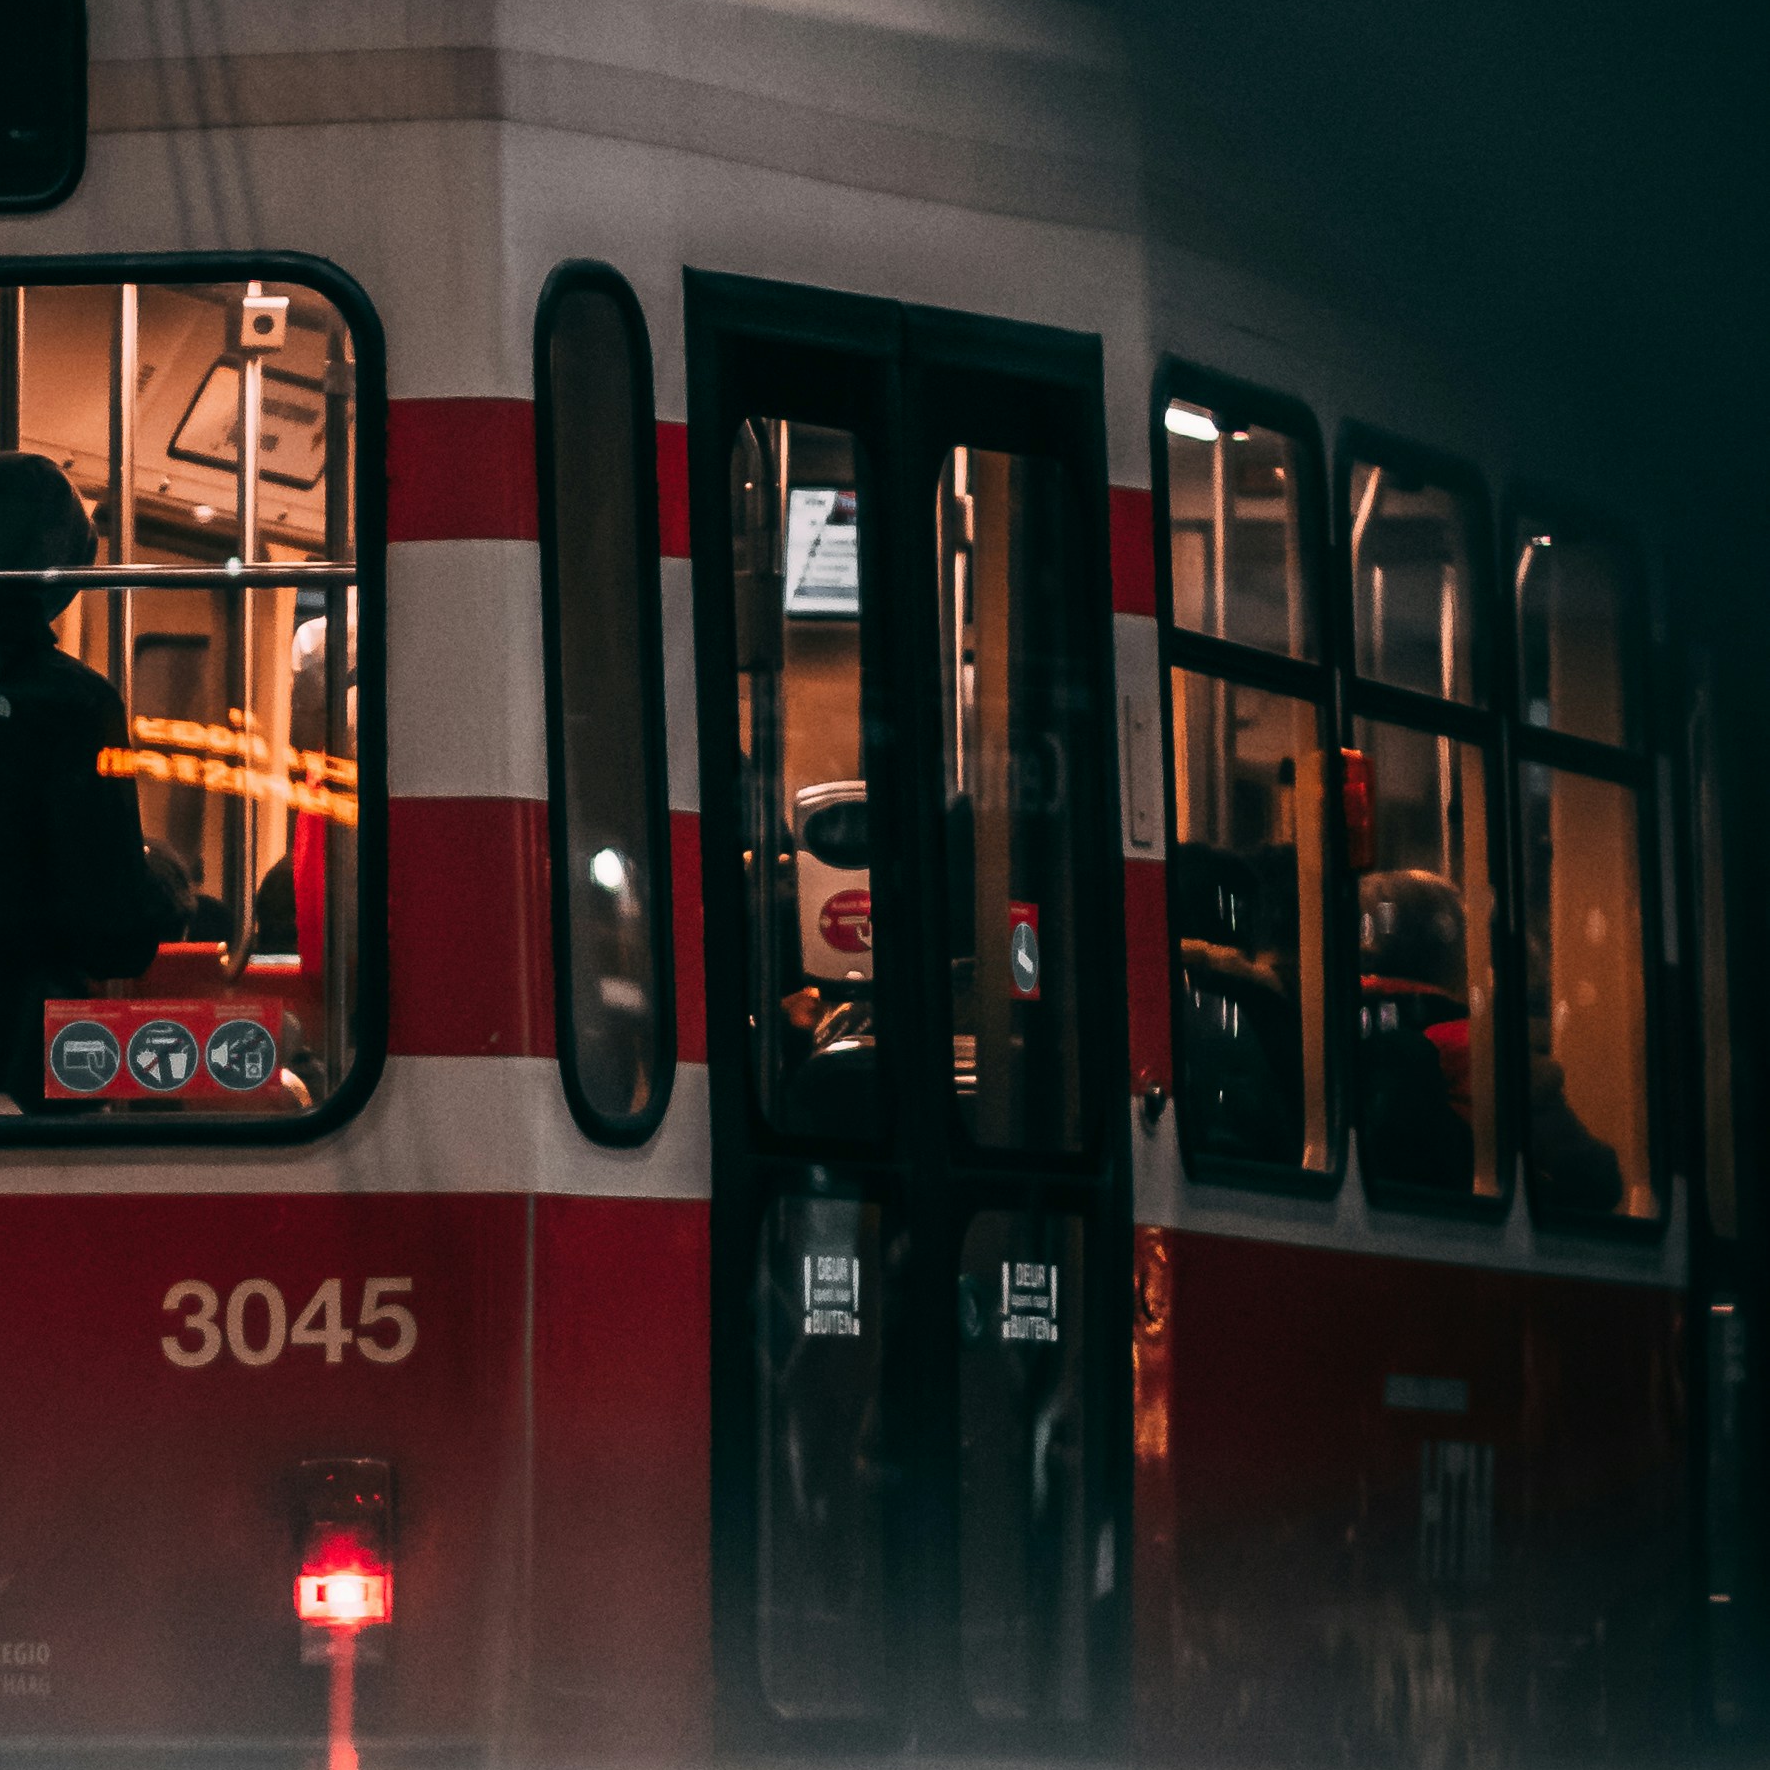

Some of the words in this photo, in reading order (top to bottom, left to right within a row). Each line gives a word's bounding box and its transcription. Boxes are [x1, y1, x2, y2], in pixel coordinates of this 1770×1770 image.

[817, 1256, 848, 1281] DEUR
[1015, 1262, 1046, 1287] DEUR
[161, 1277, 418, 1368] 3045
[812, 1309, 852, 1334] BUITEN
[1010, 1314, 1050, 1339] BUITEN
